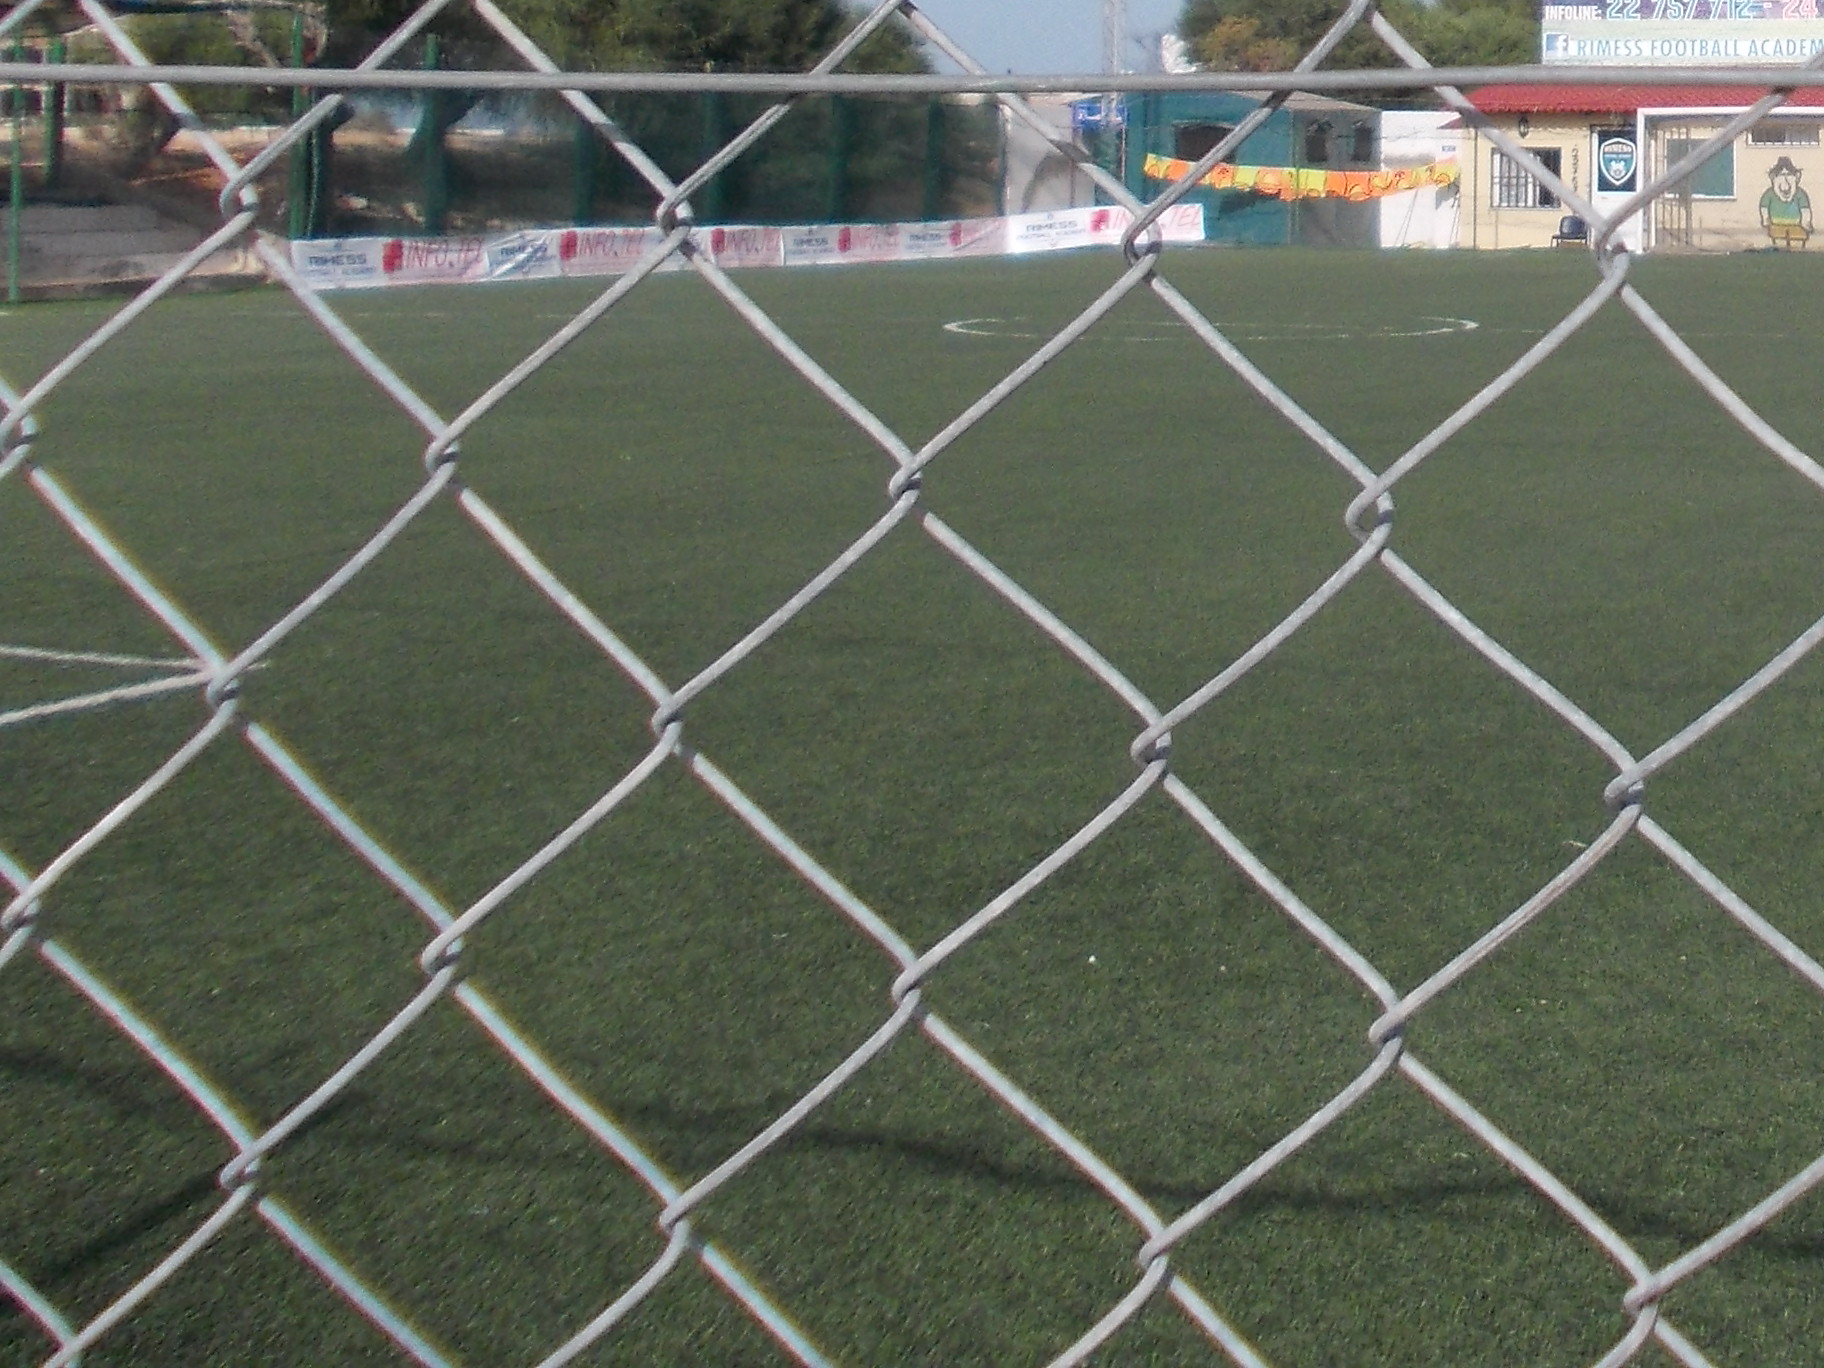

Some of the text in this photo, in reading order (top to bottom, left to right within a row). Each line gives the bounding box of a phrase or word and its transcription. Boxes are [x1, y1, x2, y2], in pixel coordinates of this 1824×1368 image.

[1545, 5, 1602, 21] INFOLINE:
[1577, 39, 1643, 57] RIMESS
[1651, 39, 1741, 57] FOOTBALL
